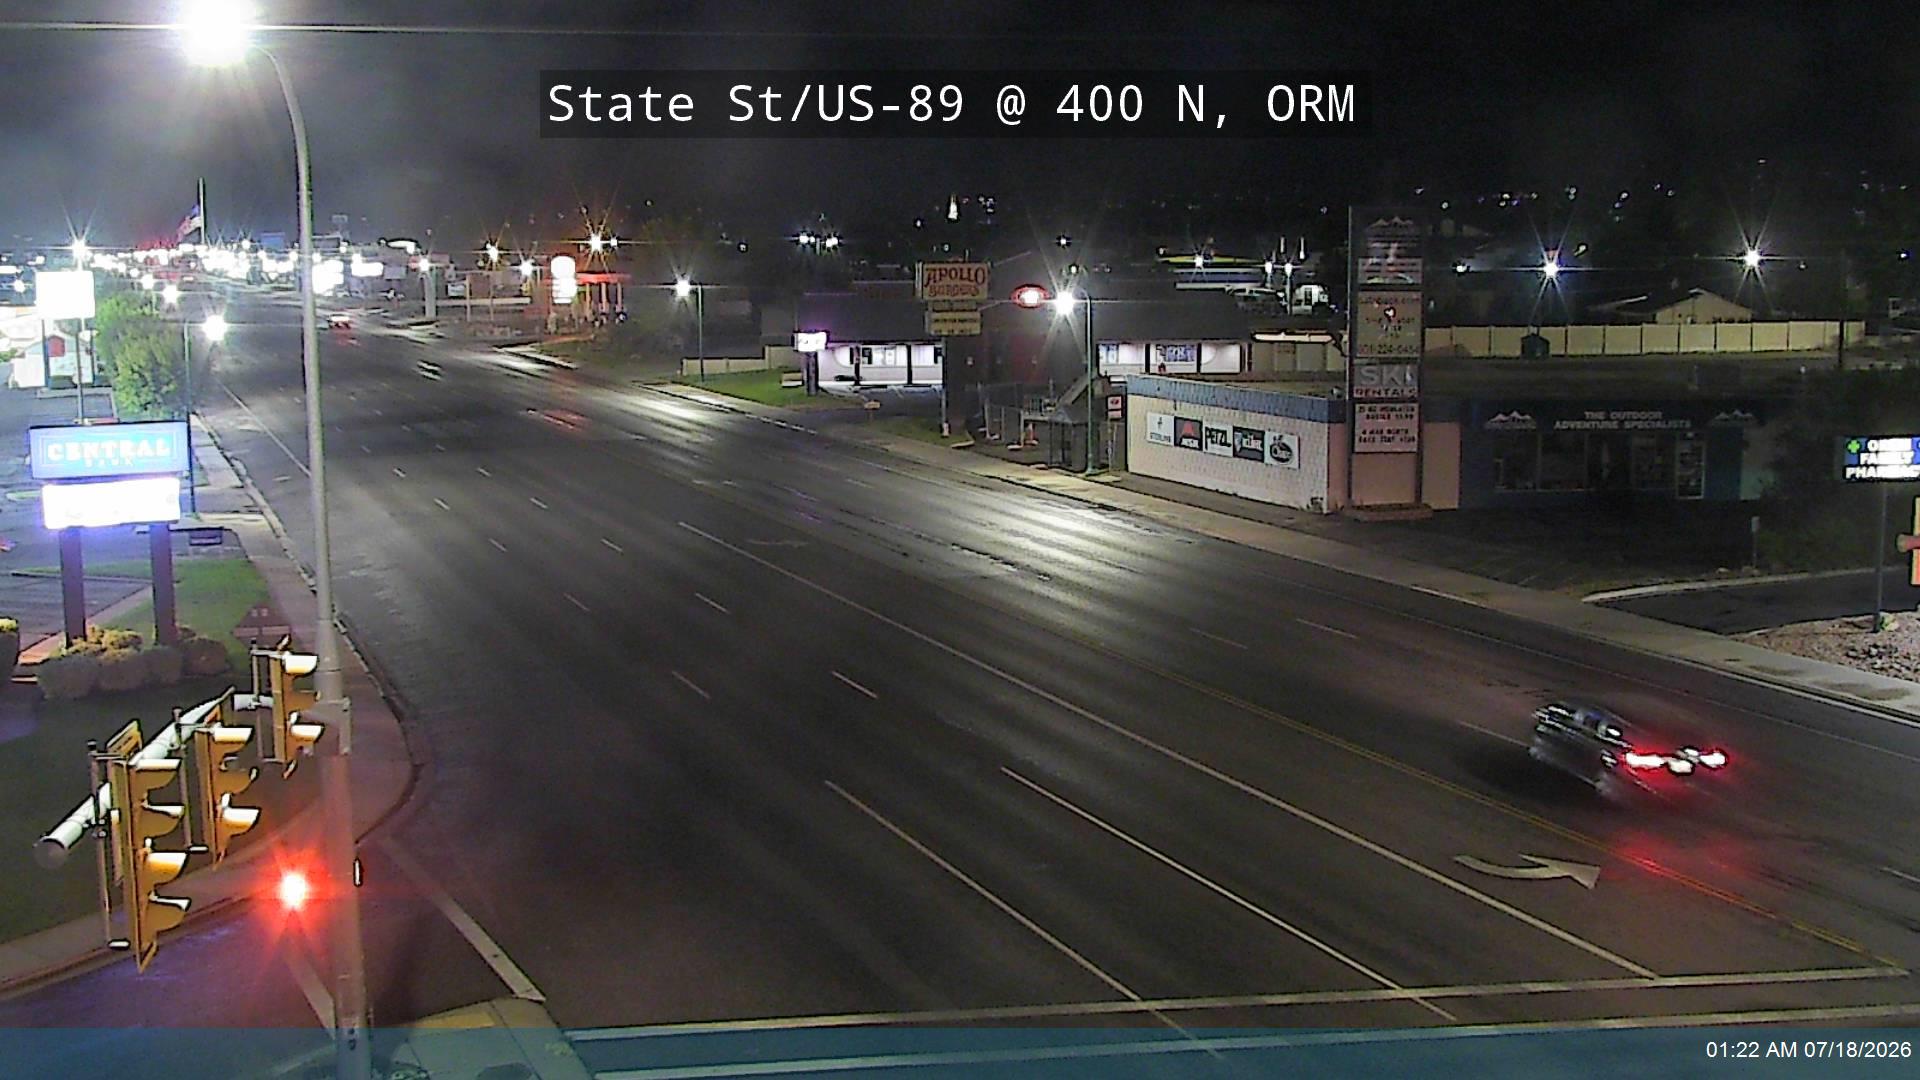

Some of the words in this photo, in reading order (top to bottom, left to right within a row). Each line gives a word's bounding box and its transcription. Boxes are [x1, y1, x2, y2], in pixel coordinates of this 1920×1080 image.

[924, 267, 986, 288] APOLLO
[1584, 411, 1606, 420] THE
[1610, 411, 1663, 420] OUTDOOR
[1553, 420, 1619, 429] ADVENTURE
[1623, 419, 1692, 429] SPECIALISTS
[47, 438, 170, 461] CENTRAL
[1860, 451, 1914, 465] FALY
